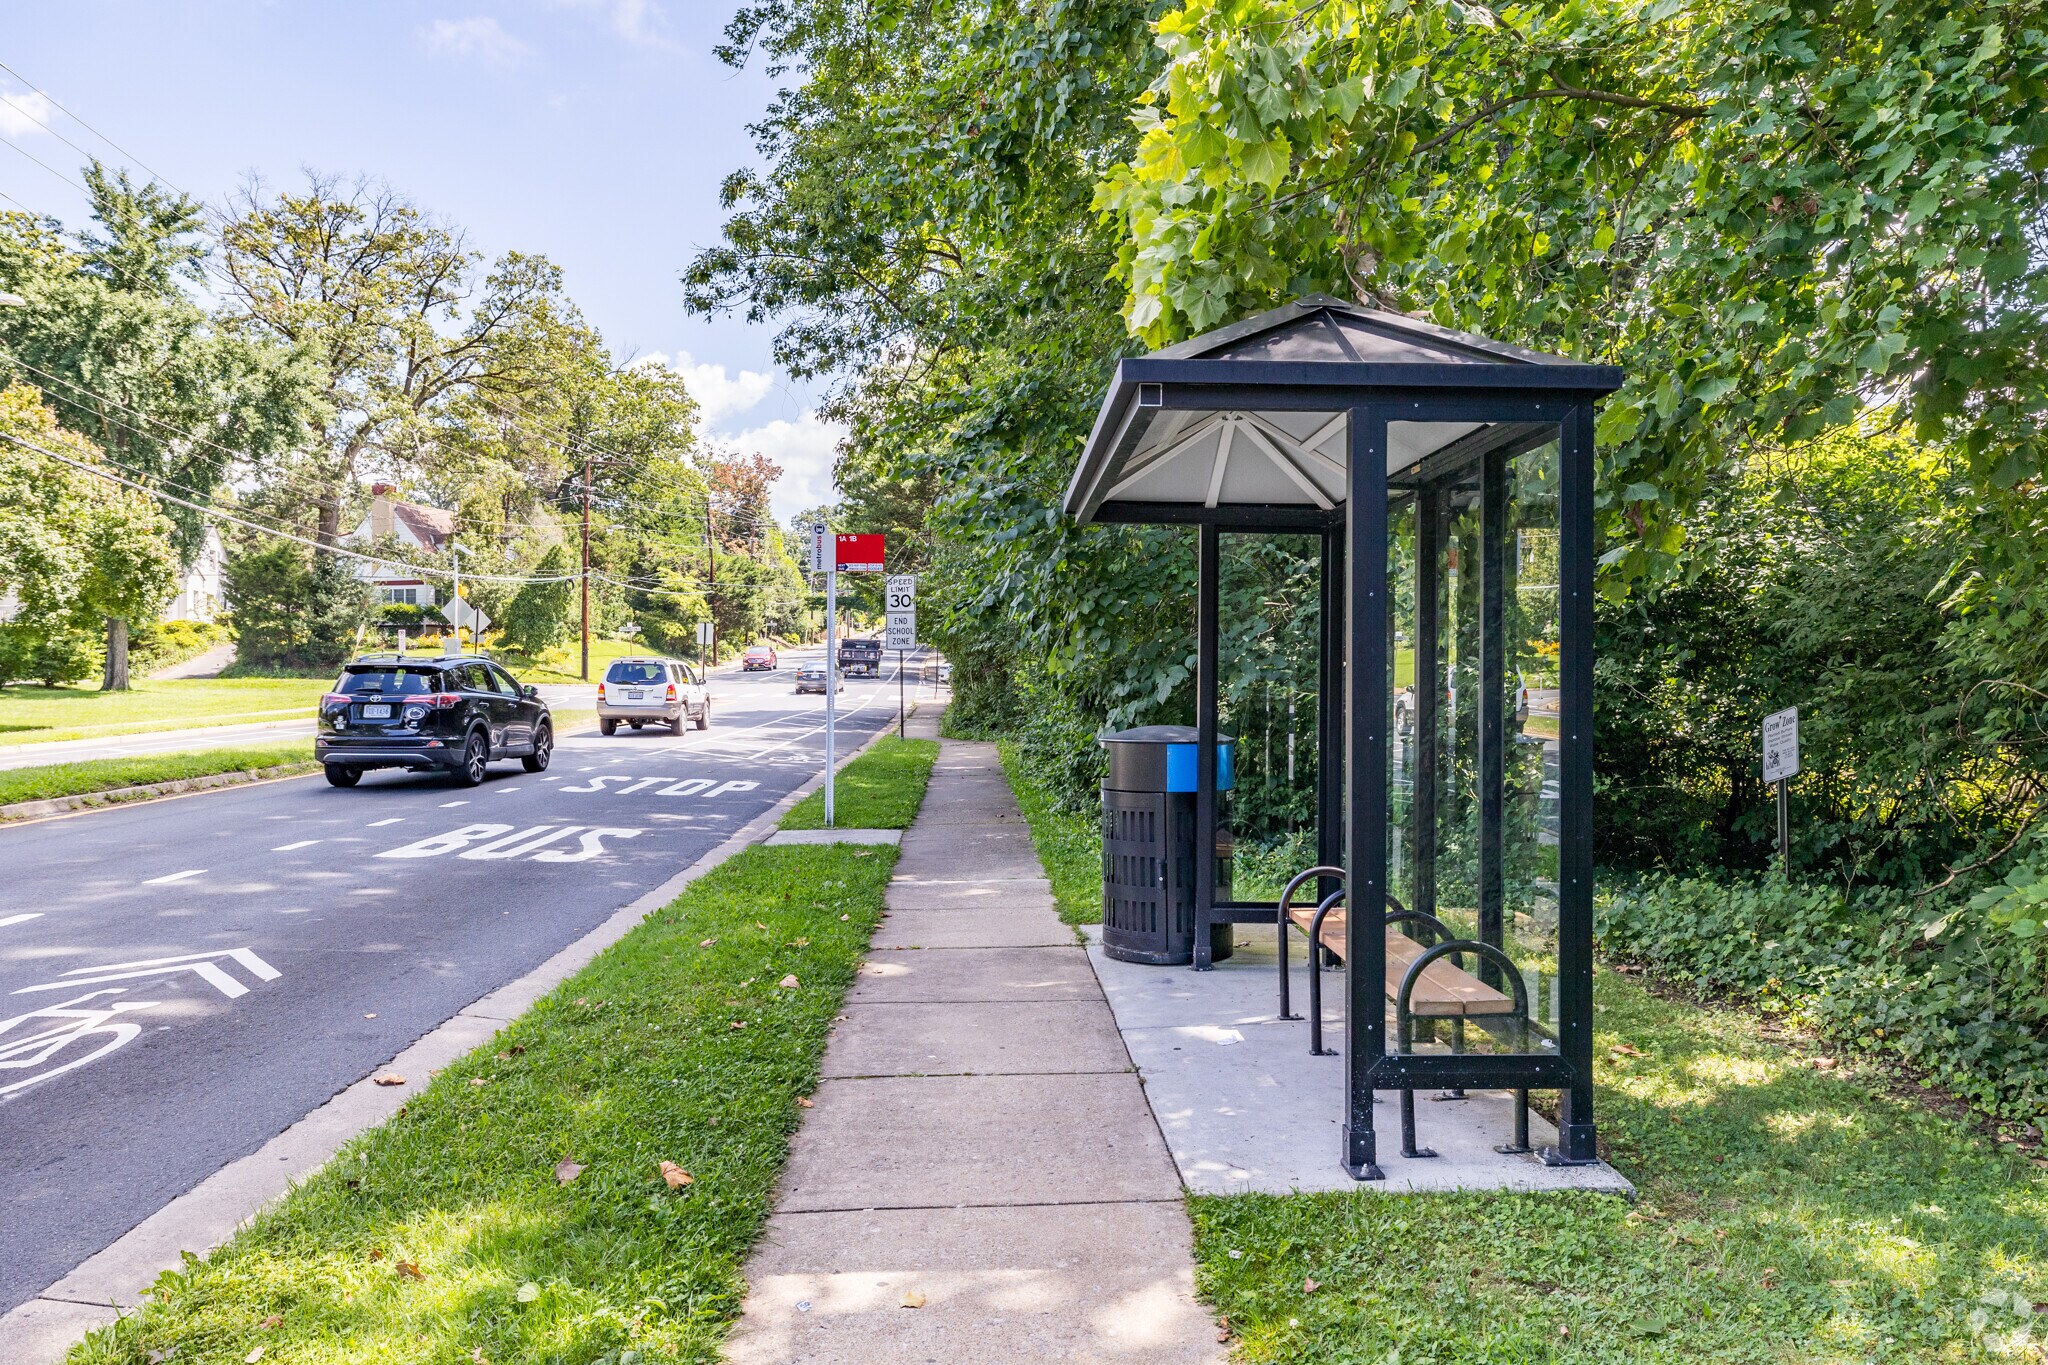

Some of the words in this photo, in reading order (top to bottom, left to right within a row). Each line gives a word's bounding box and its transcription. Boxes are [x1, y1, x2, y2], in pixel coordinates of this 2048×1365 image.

[890, 594, 911, 608] 30
[894, 617, 908, 625] END
[888, 627, 914, 635] SCHOOL
[892, 637, 910, 645] ZONE
[1765, 721, 1780, 733] Grow
[1782, 716, 1795, 727] Zone
[558, 775, 761, 798] STOP
[372, 823, 643, 863] BUS
